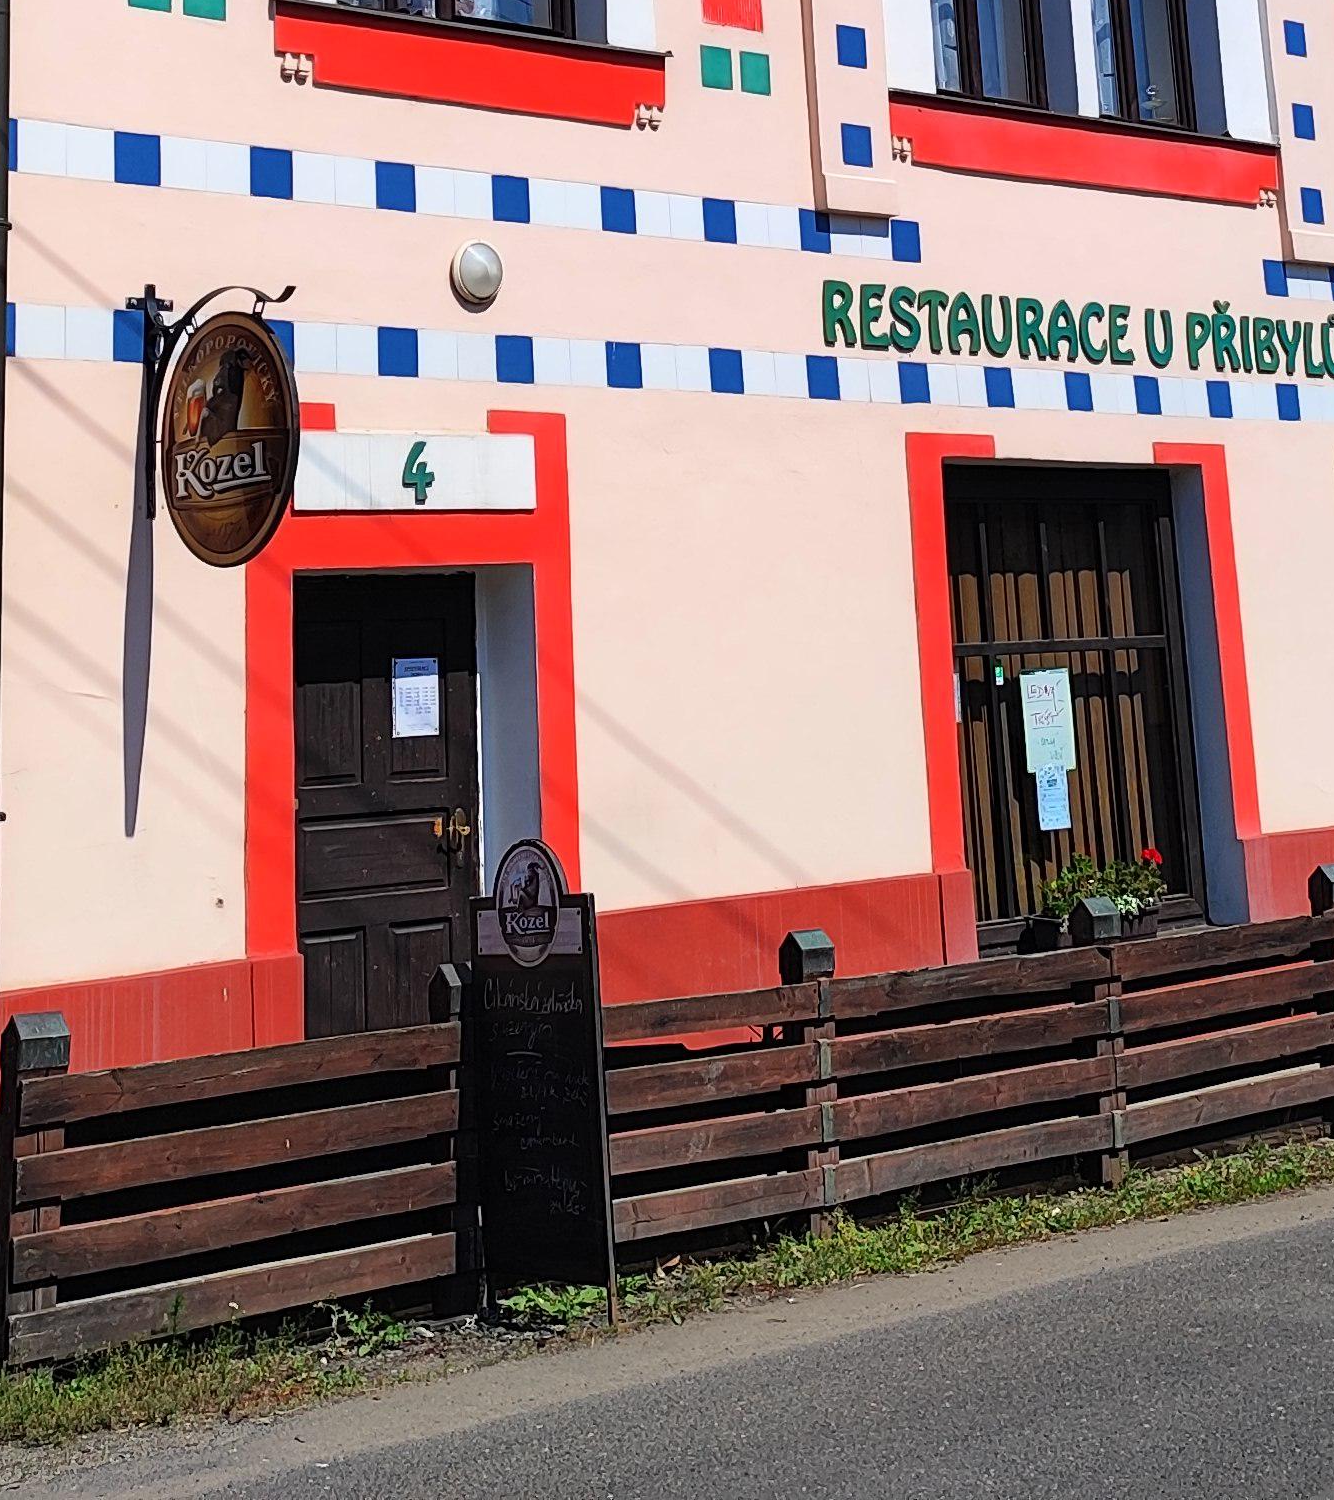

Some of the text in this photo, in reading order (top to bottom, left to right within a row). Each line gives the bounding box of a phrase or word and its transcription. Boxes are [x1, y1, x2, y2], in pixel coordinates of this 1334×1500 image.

[822, 279, 1135, 366] RESTAURACE
[1144, 308, 1174, 370] U
[174, 441, 272, 499] Kozel
[402, 441, 436, 506] 4
[505, 911, 551, 935] Kozel
